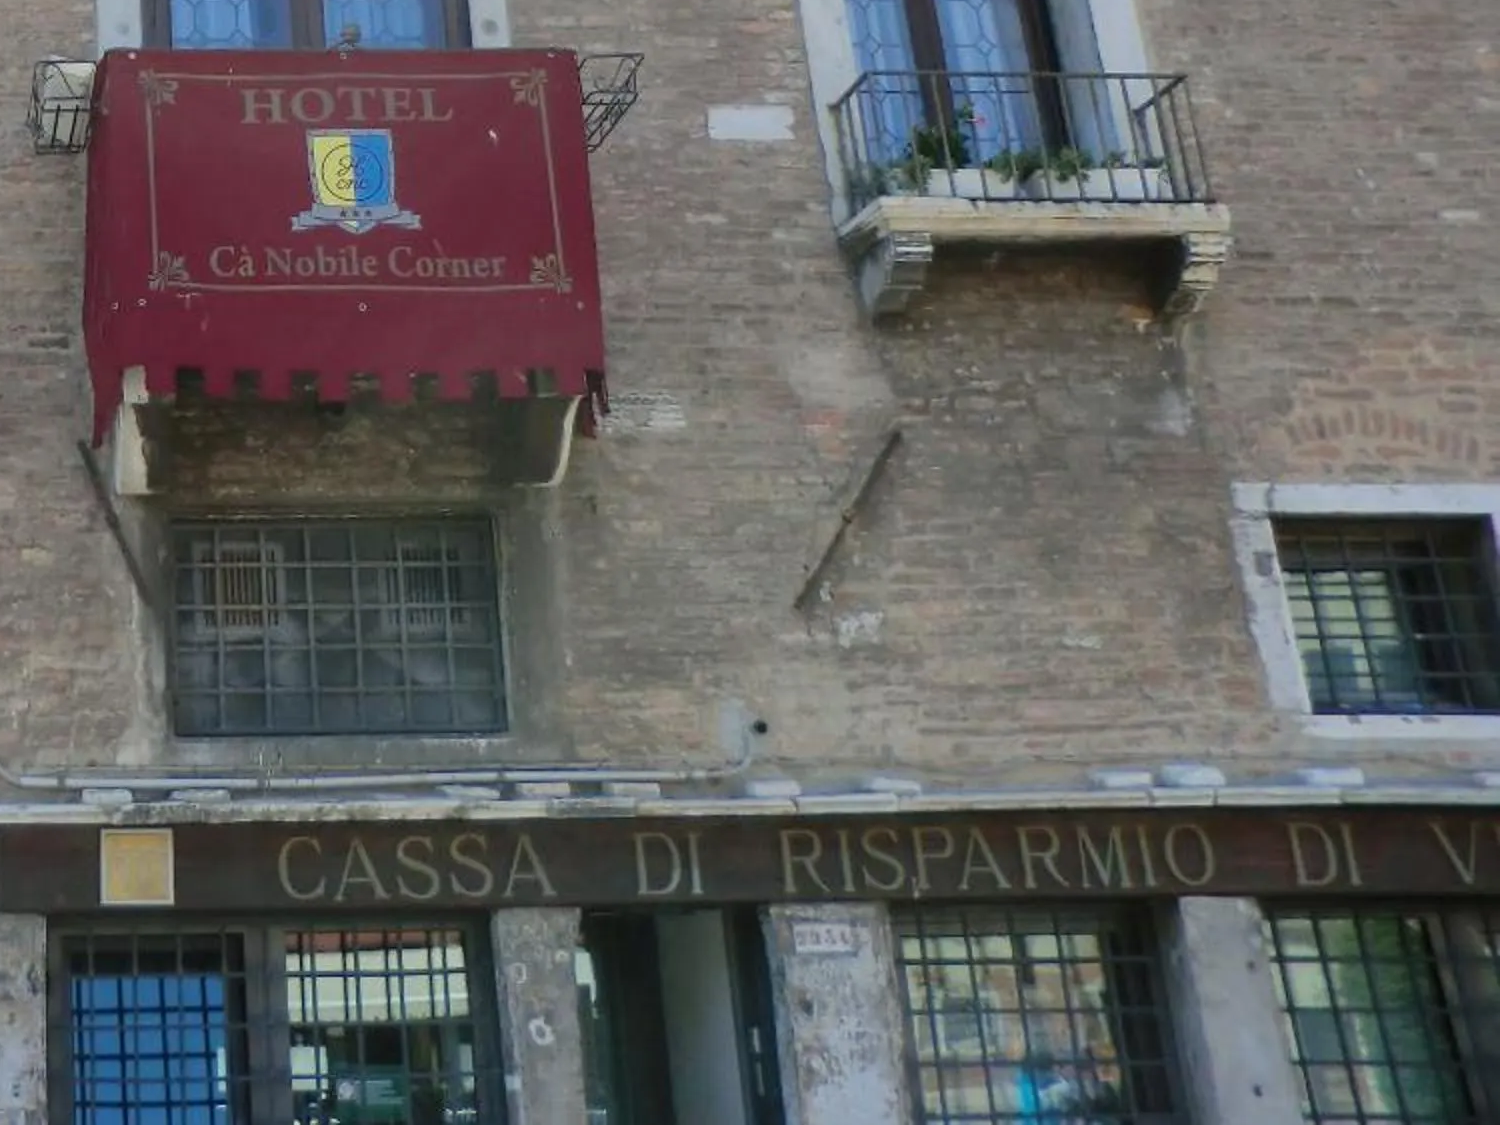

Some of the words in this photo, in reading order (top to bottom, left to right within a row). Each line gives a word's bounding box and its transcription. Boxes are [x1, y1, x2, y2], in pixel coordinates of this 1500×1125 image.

[240, 86, 453, 124] HOTEL
[209, 245, 255, 277] Cà
[264, 245, 379, 277] Nobile
[387, 244, 506, 278] Corner
[276, 830, 559, 903] CASSA
[633, 831, 705, 896] DI
[779, 824, 1218, 894] RISPARMIO
[1286, 821, 1364, 888] DI
[1428, 818, 1500, 886] V
